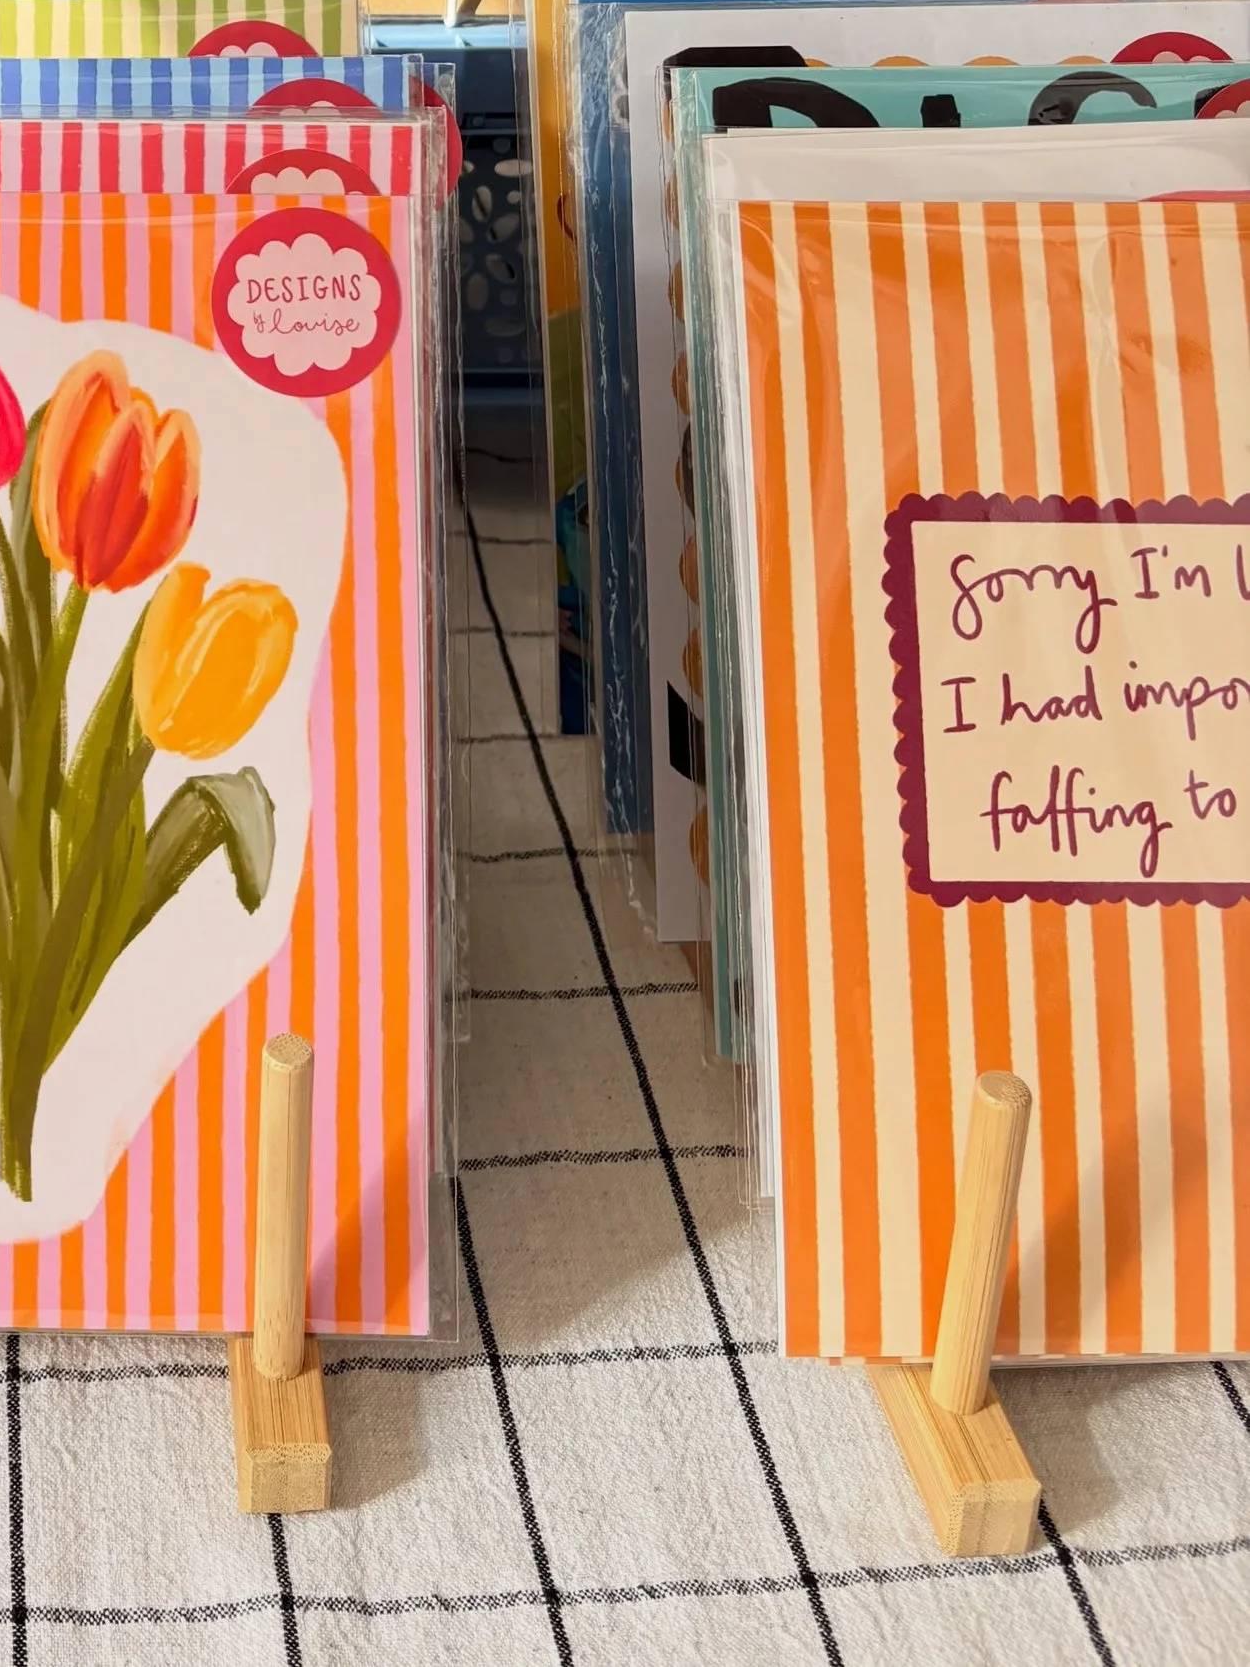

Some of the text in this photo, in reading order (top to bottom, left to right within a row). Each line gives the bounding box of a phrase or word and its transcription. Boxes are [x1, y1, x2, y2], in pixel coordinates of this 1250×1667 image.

[246, 274, 361, 304] DESIGNS
[253, 308, 360, 336] by louise
[1130, 544, 1212, 599] I'm
[940, 676, 977, 733] I
[1000, 665, 1103, 725] had
[979, 764, 1237, 878] faffing to
